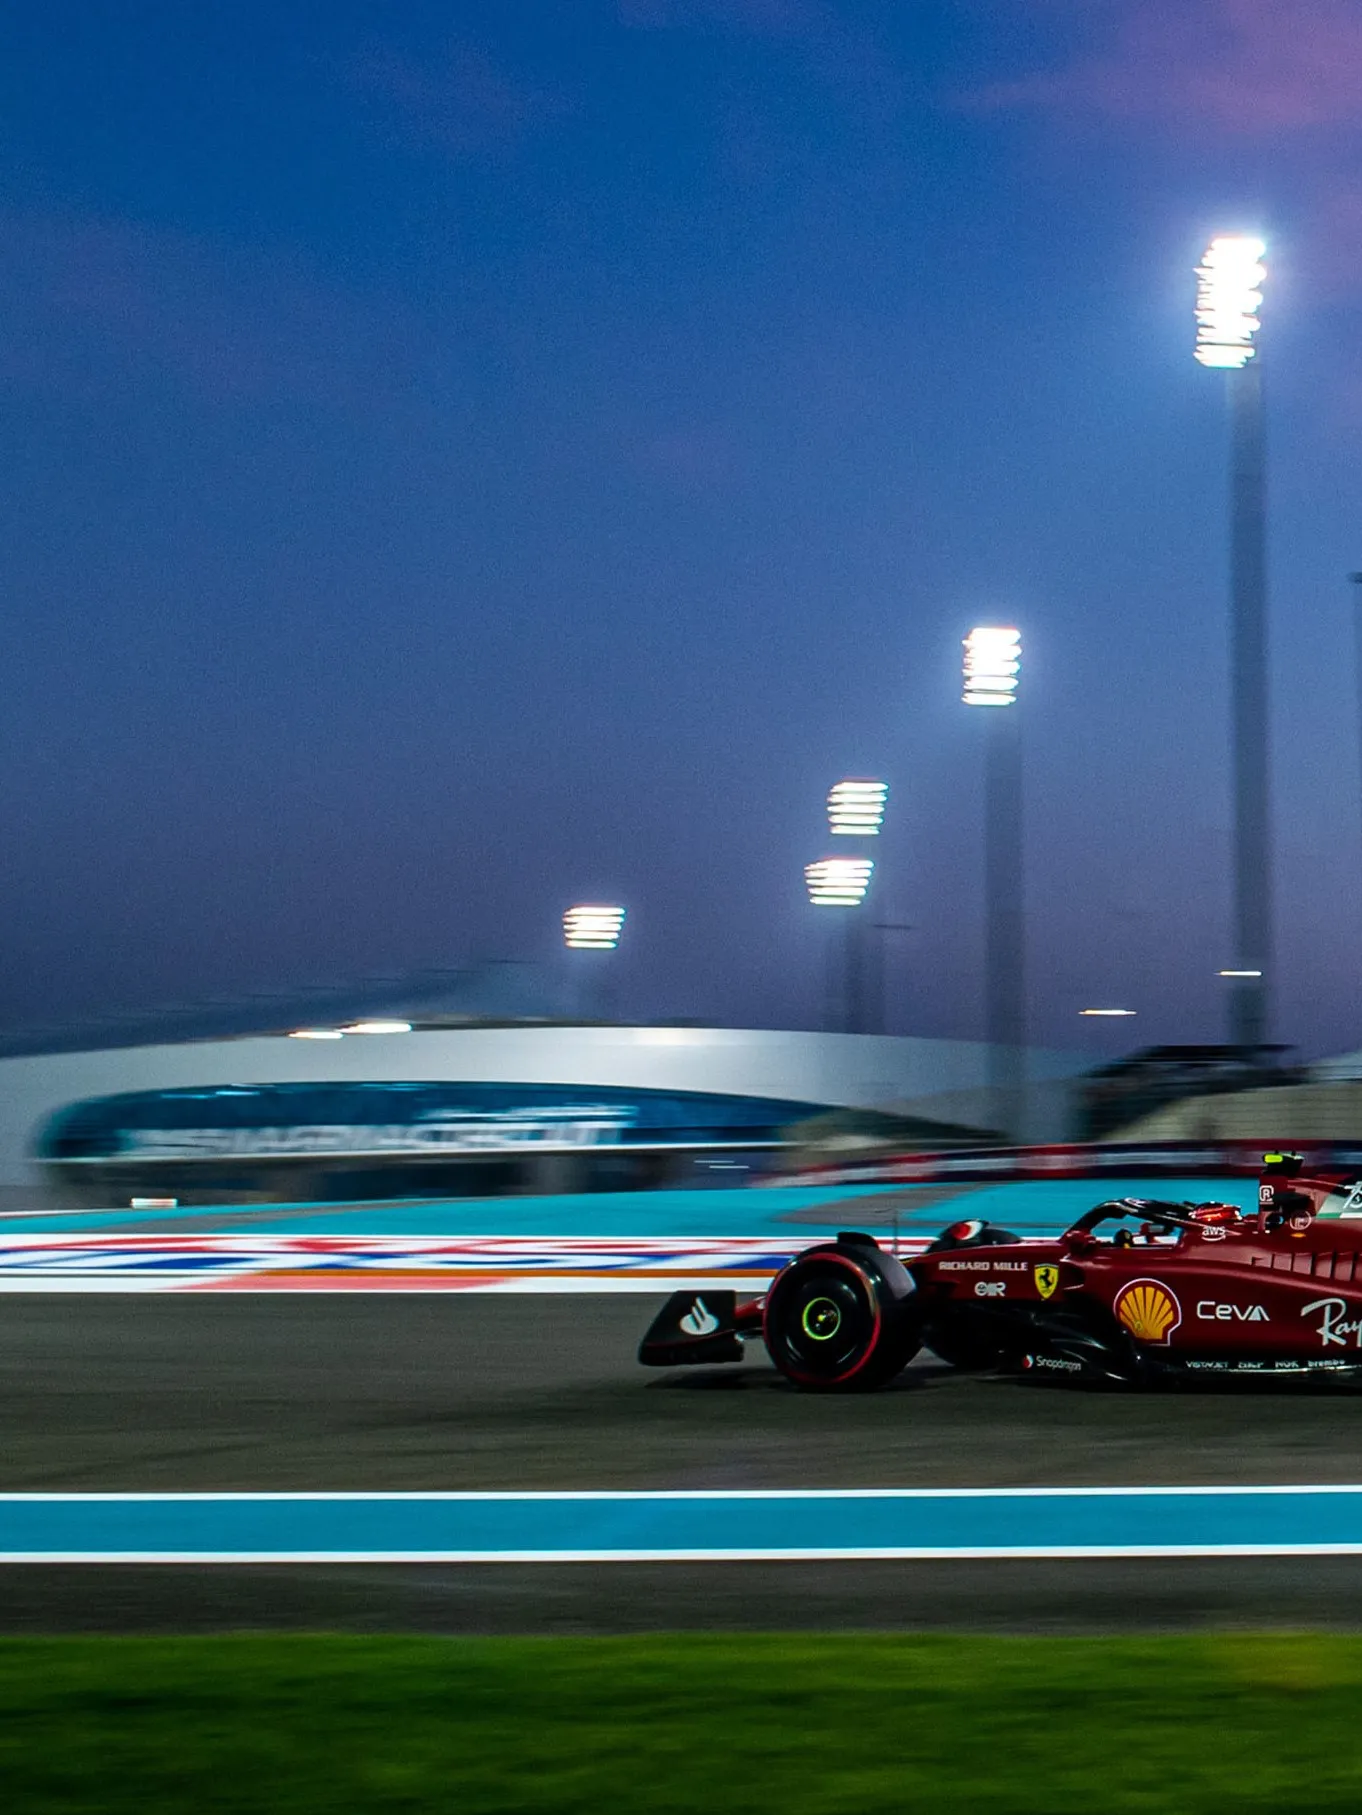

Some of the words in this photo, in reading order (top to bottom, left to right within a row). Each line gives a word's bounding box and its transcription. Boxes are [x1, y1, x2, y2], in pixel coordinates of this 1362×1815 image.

[1202, 1226, 1226, 1237] aws
[939, 1261, 990, 1271] RICHARD
[993, 1261, 1028, 1271] MILLE
[1036, 1355, 1081, 1373] Snapdragon
